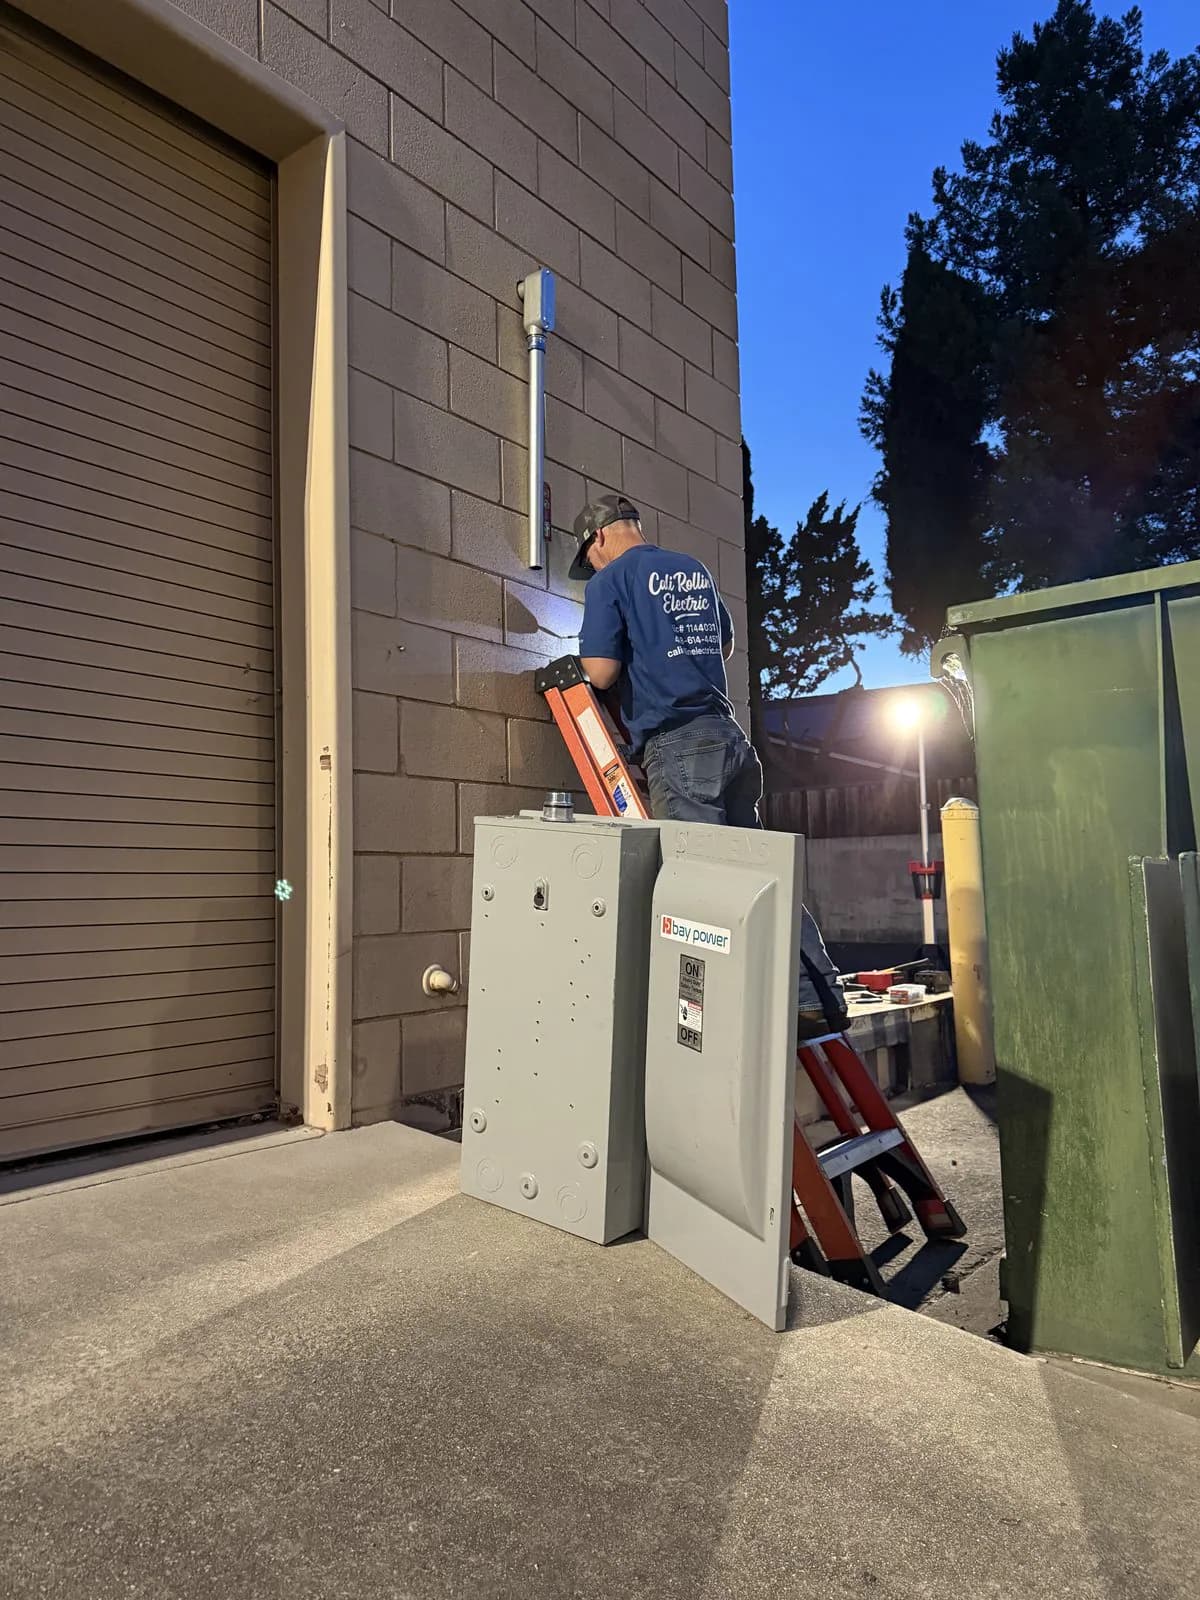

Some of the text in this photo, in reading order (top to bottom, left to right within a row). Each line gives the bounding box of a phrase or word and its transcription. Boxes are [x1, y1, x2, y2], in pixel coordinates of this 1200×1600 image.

[648, 571, 675, 596] Cali
[663, 592, 710, 614] Electric
[672, 919, 729, 948] bay power
[685, 961, 700, 978] ON
[680, 1027, 699, 1045] OFF
